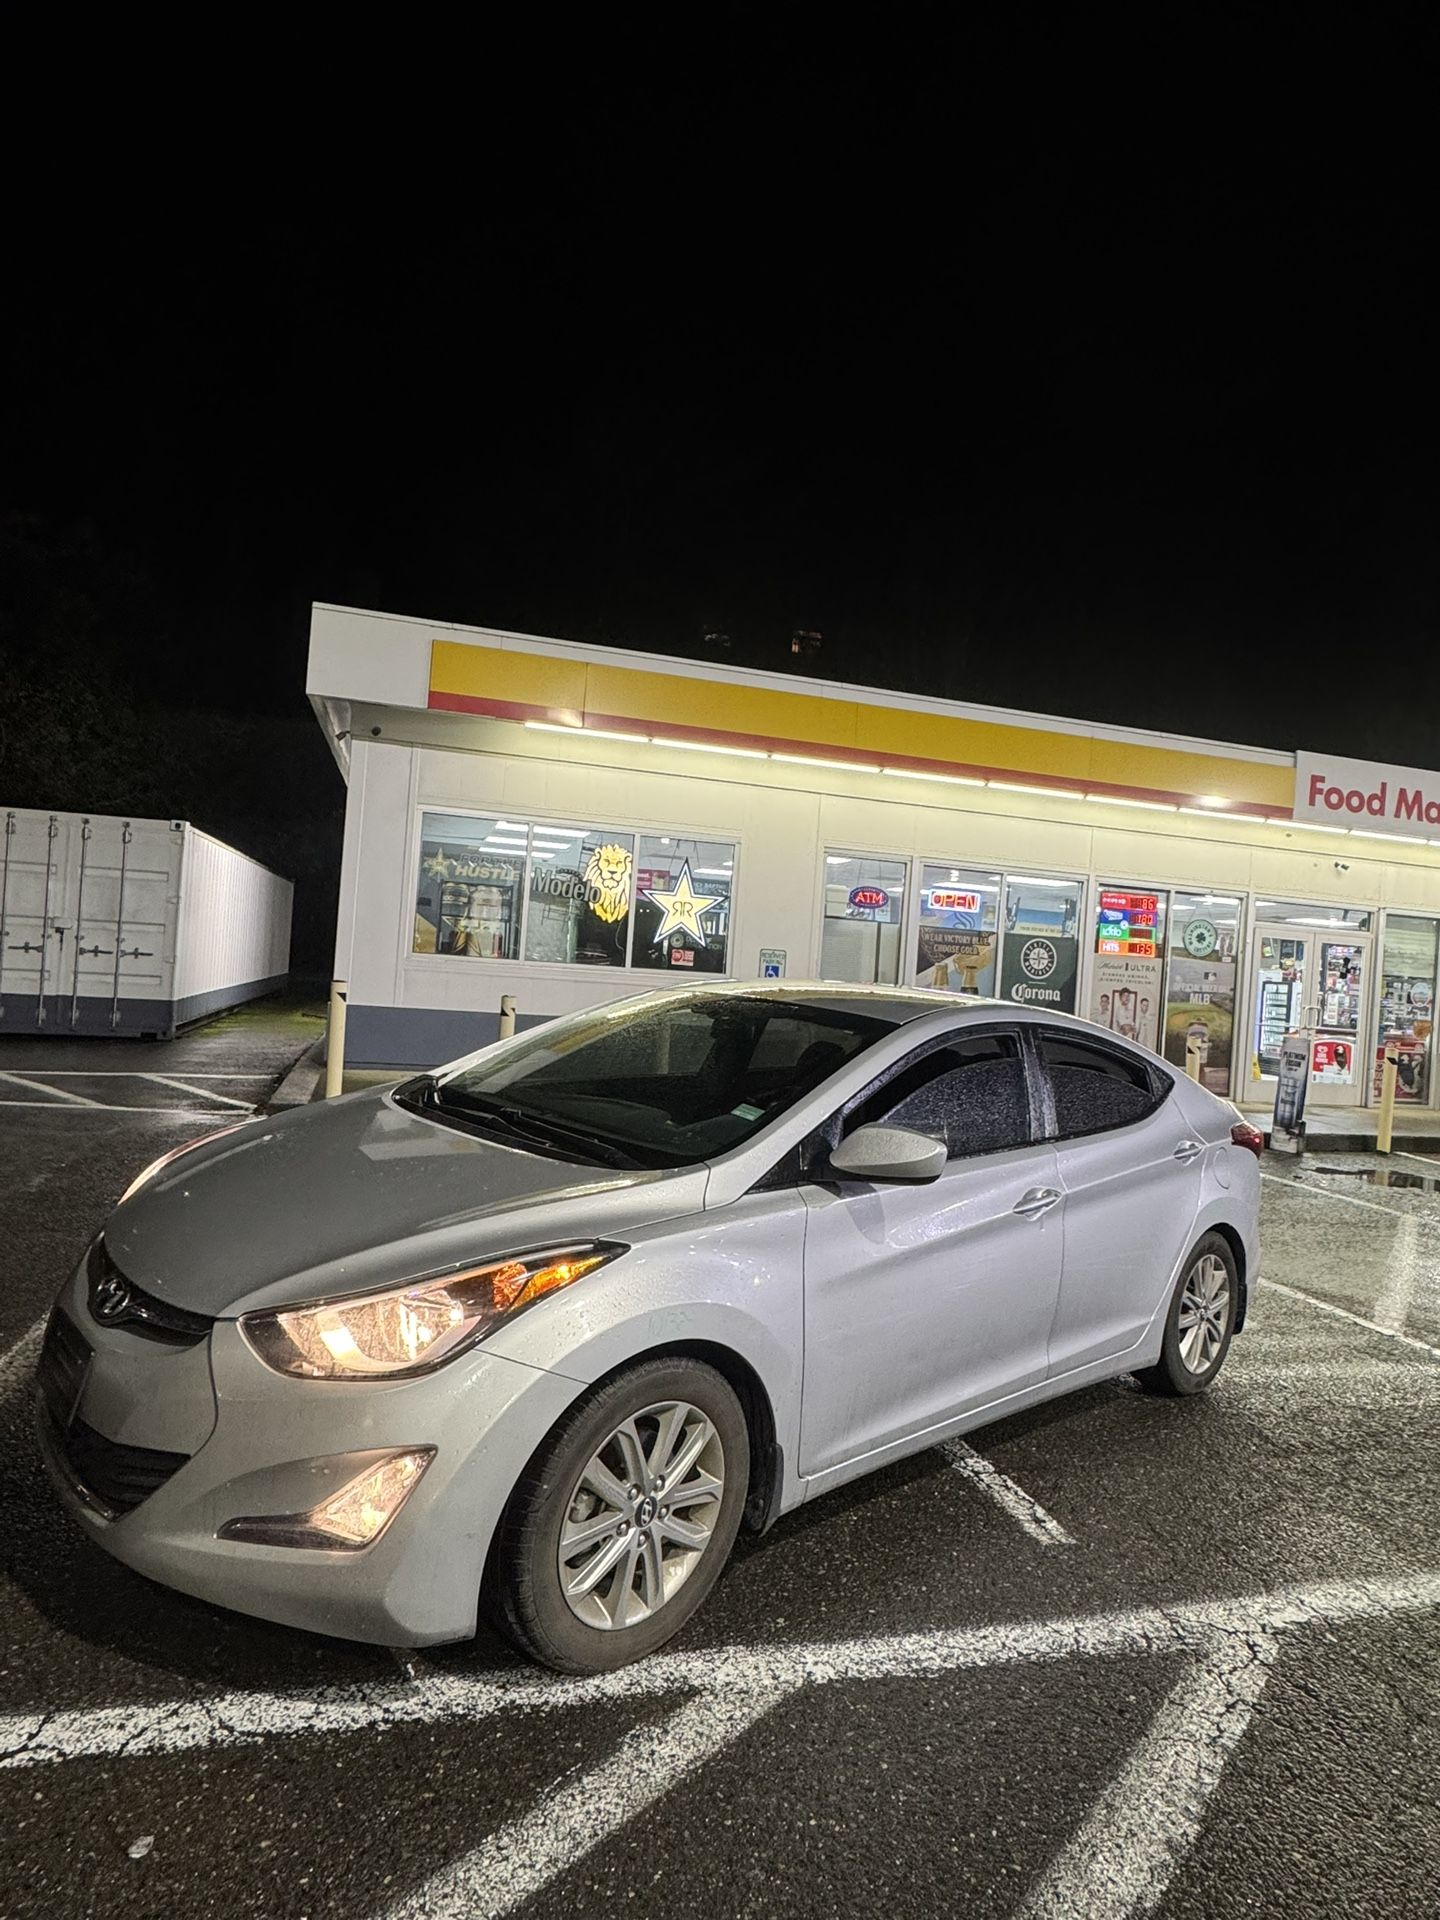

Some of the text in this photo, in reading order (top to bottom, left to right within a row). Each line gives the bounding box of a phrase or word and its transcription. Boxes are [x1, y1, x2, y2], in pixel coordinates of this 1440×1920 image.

[1308, 774, 1387, 816] Food
[455, 864, 520, 881] HUSTLE
[532, 866, 602, 904] Modelo
[855, 891, 883, 904] ATM
[931, 892, 978, 910] OPEN
[924, 932, 944, 943] WEAR
[944, 934, 971, 945] VICTORY
[761, 951, 785, 960] RESERVED
[934, 943, 979, 955] CHOOSE GOLD
[1130, 964, 1156, 973] ULTRA
[1011, 983, 1061, 1003] Corona
[1190, 993, 1210, 1006] MLB
